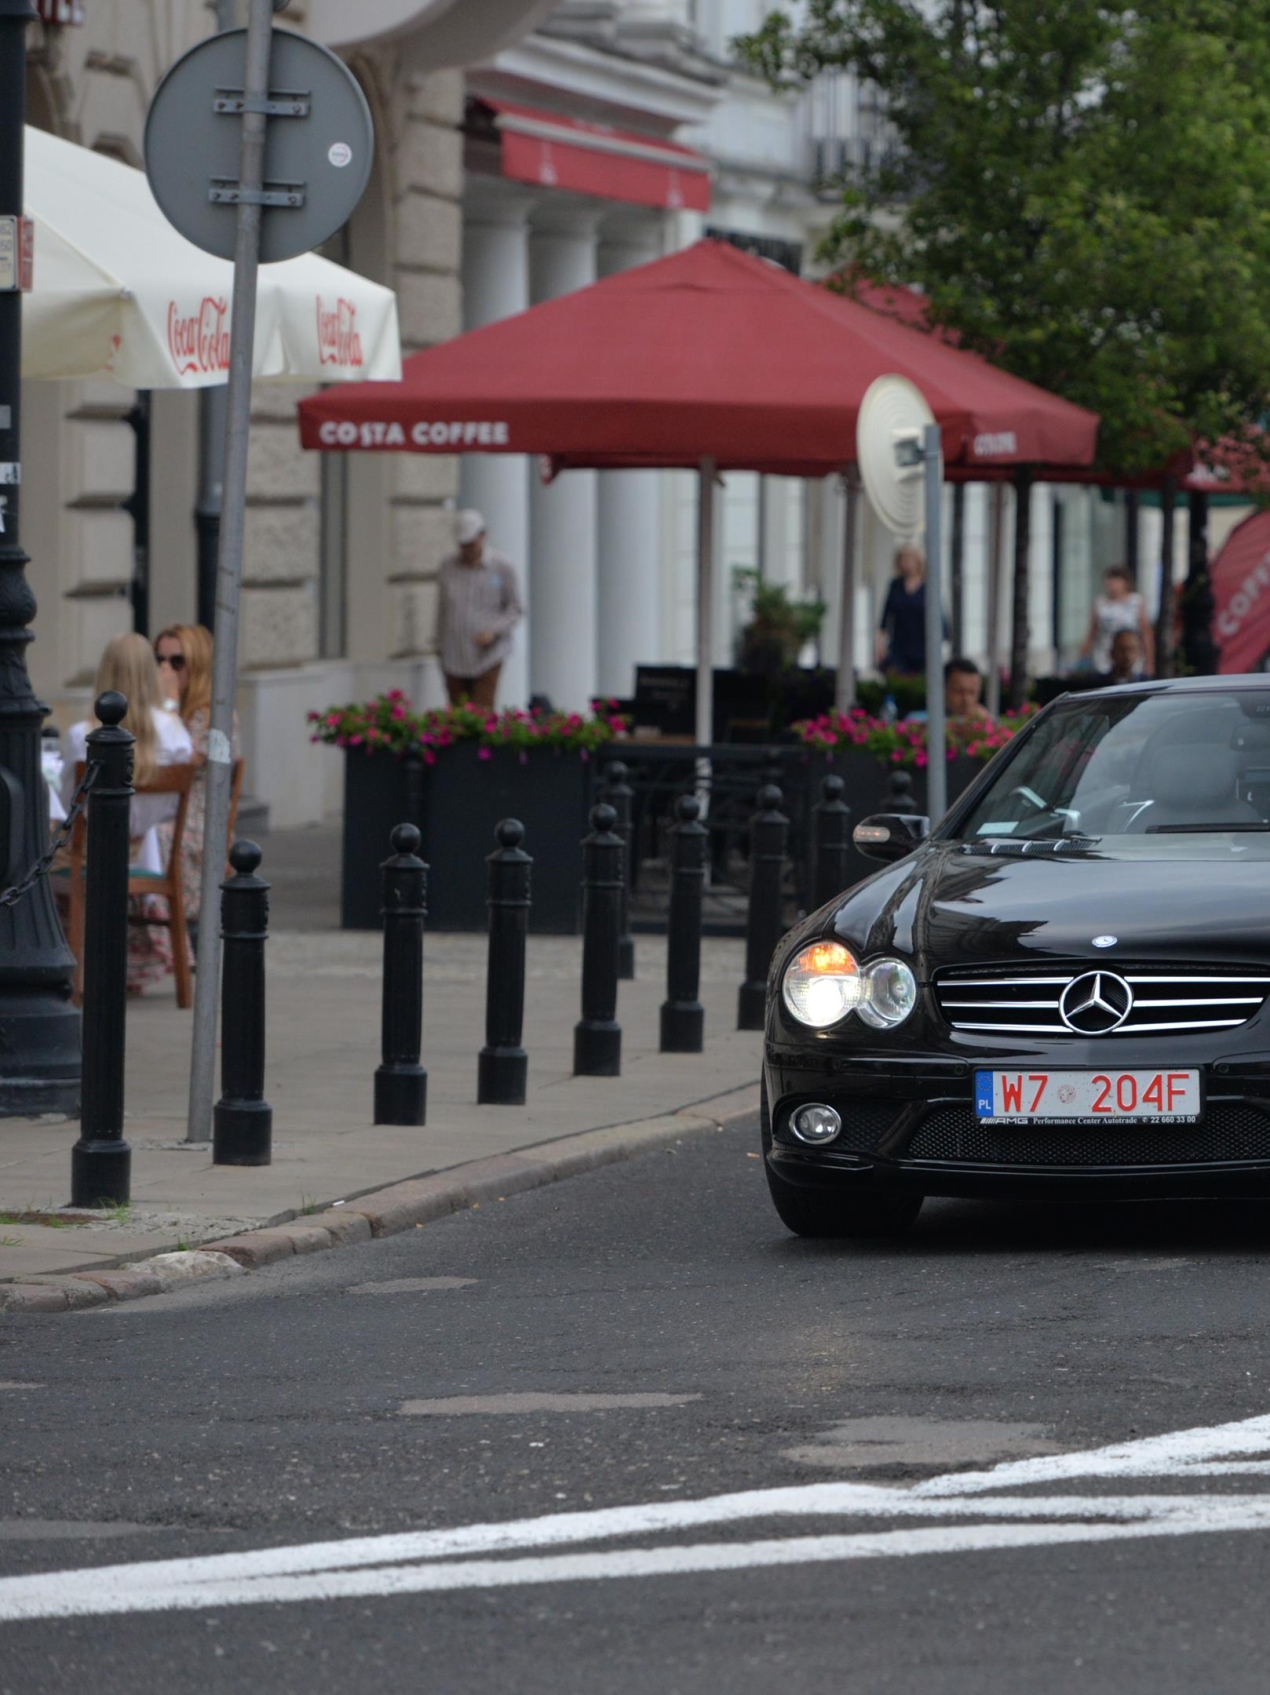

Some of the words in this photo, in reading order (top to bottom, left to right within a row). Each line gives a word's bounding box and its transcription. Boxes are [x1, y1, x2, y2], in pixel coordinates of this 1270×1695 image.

[319, 421, 405, 446] COSTA
[411, 421, 509, 445] COFFEE
[1002, 1075, 1048, 1112] W7
[1091, 1073, 1189, 1112] 204F
[978, 1099, 991, 1110] PL
[994, 1117, 1028, 1125] AMG
[1033, 1117, 1075, 1125] Performance
[1078, 1117, 1100, 1125] Center
[1102, 1117, 1137, 1125] Autotrade
